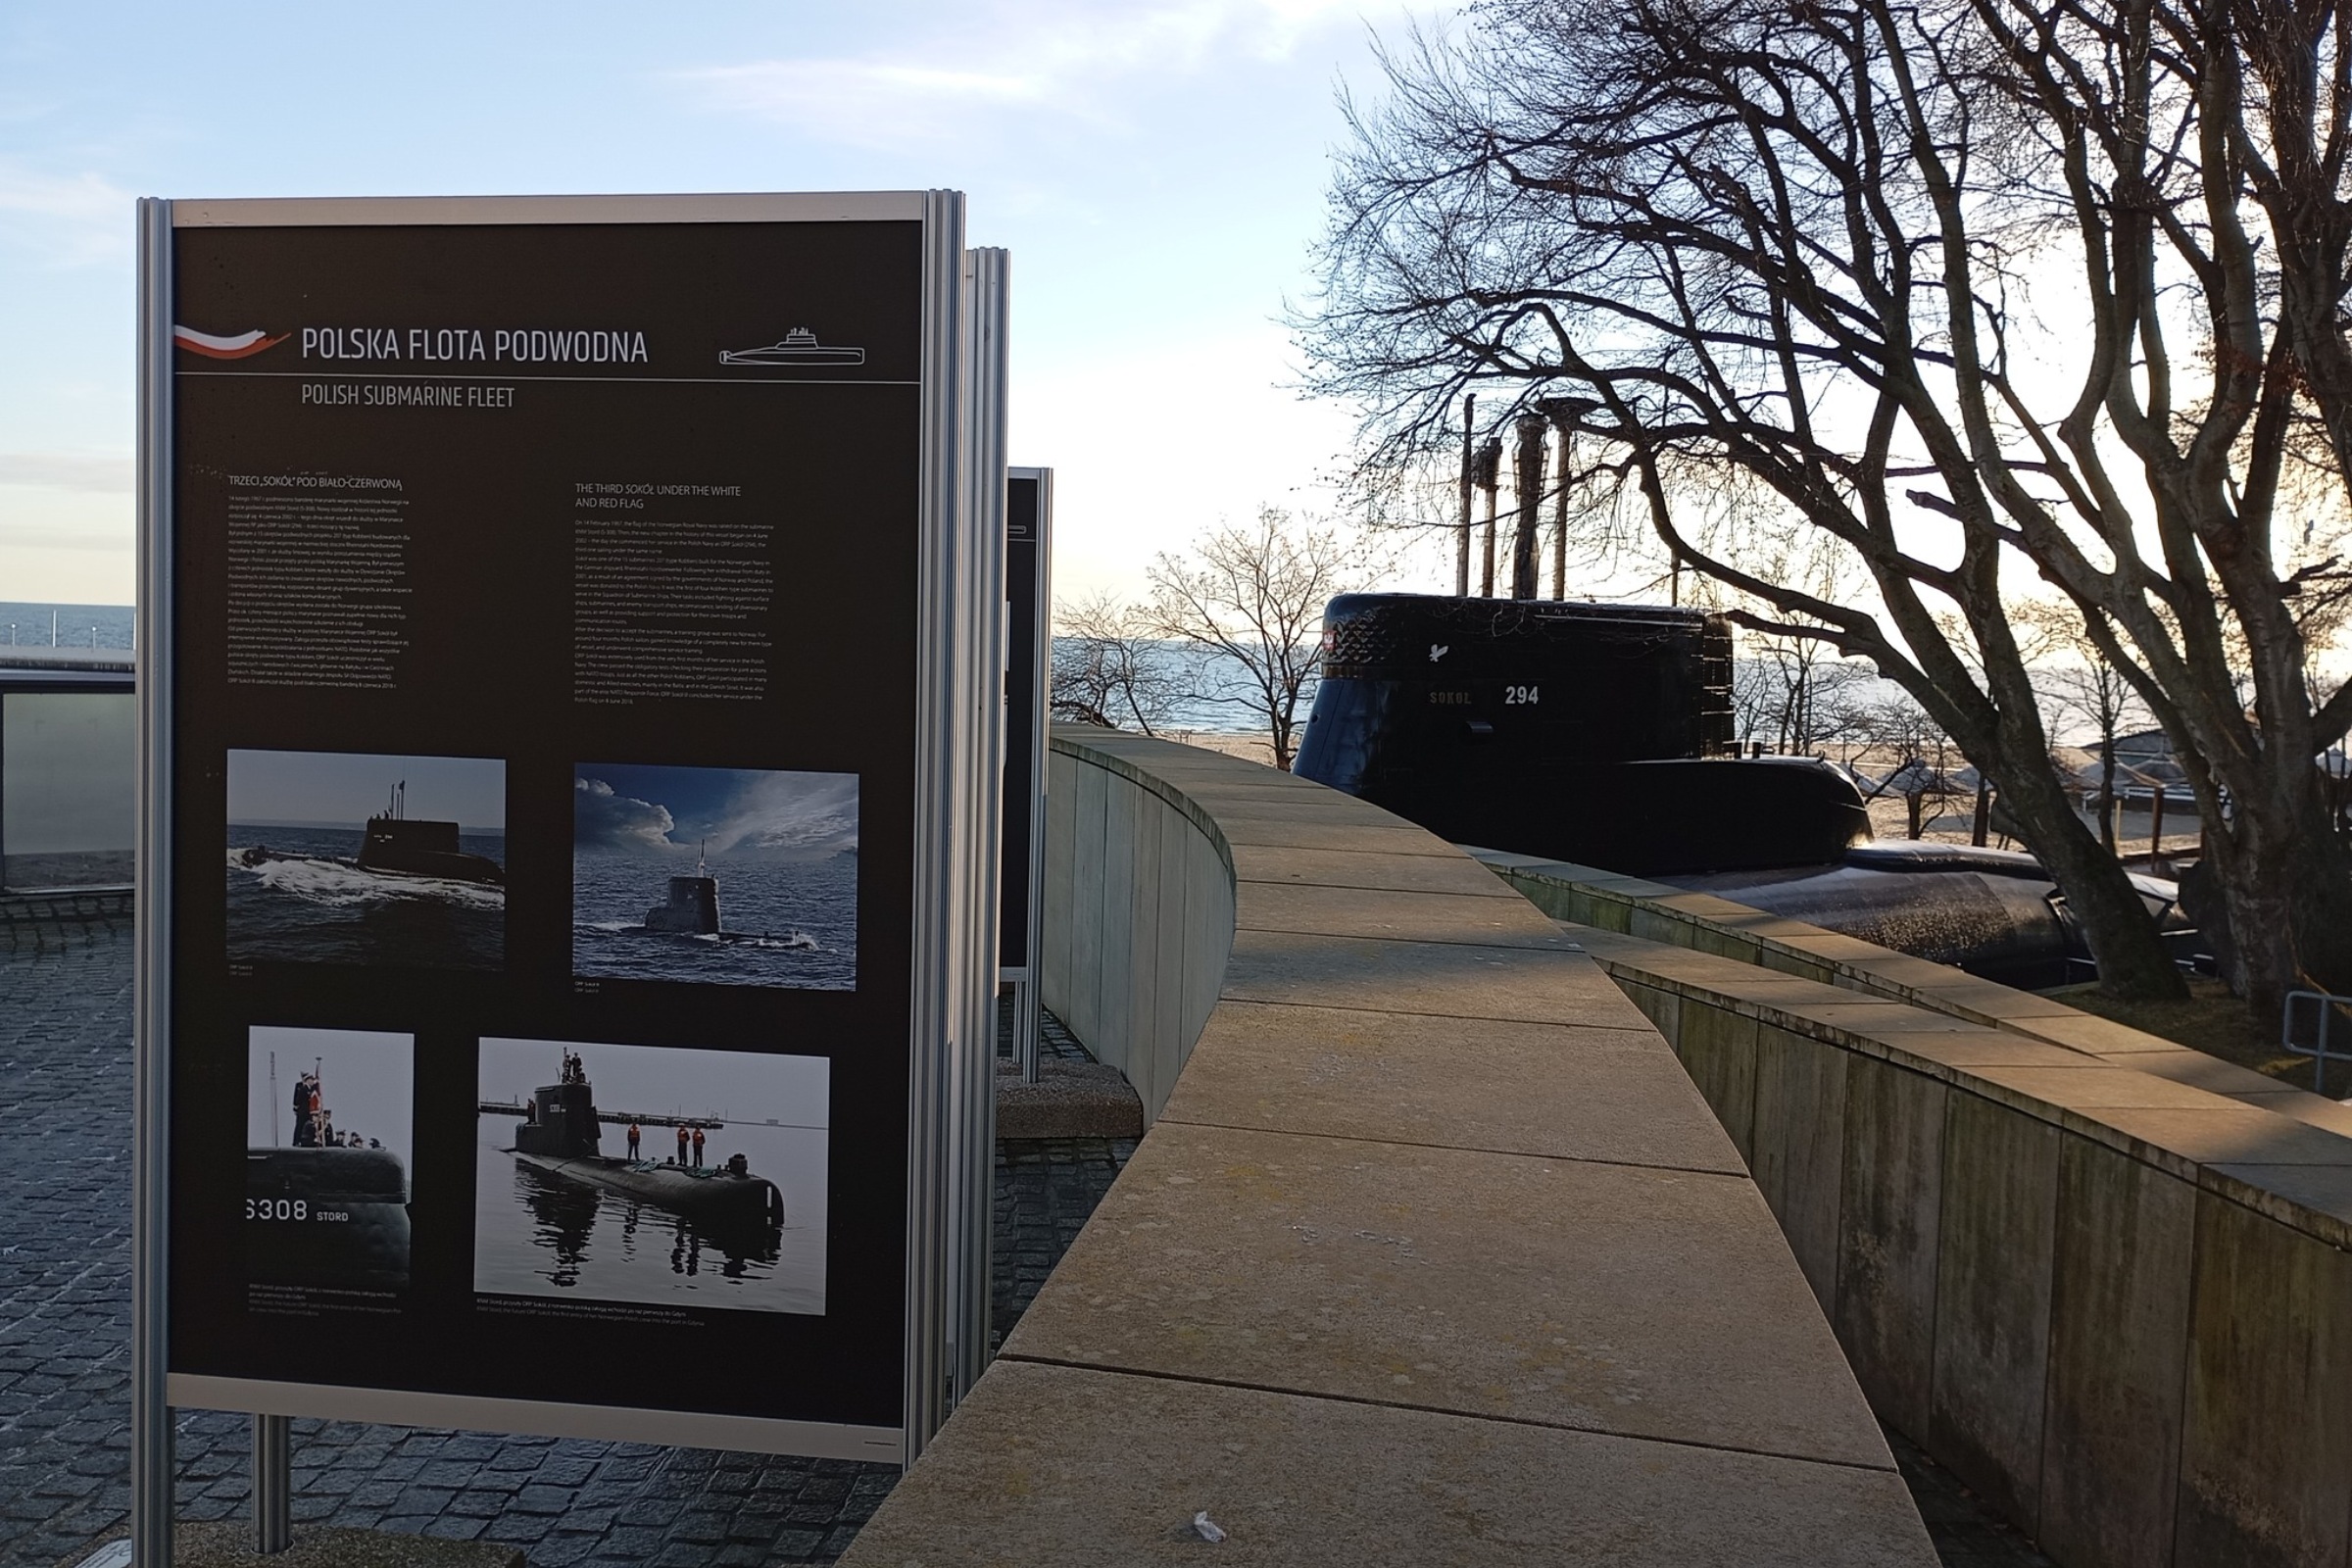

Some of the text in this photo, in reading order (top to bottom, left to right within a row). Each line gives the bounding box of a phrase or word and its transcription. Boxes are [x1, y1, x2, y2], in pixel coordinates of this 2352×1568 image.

[302, 327, 649, 363] POLSKA FLOTA PODWODNA
[301, 383, 515, 407] POLISH SUBMARINE FLEET
[228, 475, 260, 486] TRZECI
[296, 477, 318, 487] POD
[575, 483, 594, 493] THE
[595, 483, 623, 494] THIRD
[657, 485, 690, 496] UNDER
[691, 485, 710, 496] THE
[710, 486, 742, 497] WHITE
[575, 498, 644, 509] AND RED FLAG
[1505, 686, 1539, 705] 294
[317, 1211, 349, 1222] STORD
